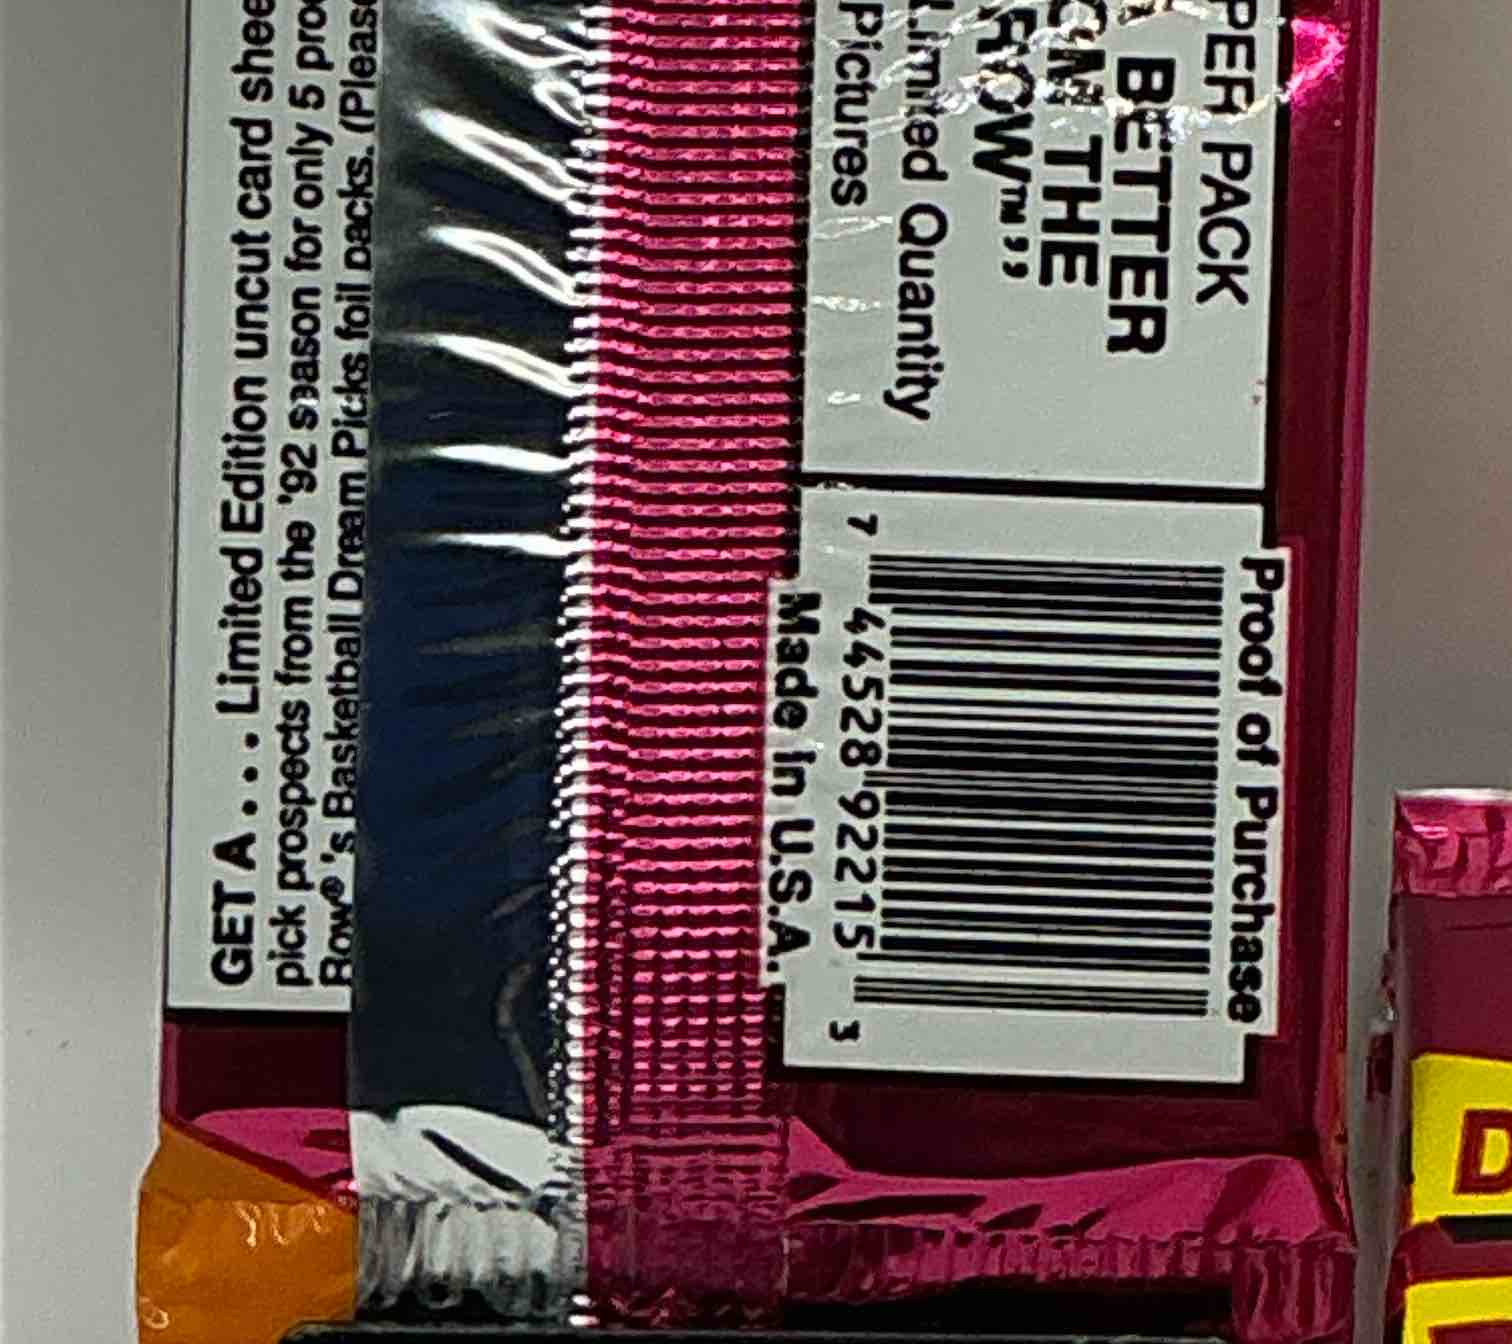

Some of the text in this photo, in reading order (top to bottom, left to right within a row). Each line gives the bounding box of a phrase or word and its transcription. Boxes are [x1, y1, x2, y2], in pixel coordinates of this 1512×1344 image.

[288, 83, 326, 111] 5
[830, 1, 884, 206] Pictures
[230, 118, 273, 220] card
[287, 122, 333, 210] only
[337, 145, 375, 272] packs.
[1039, 133, 1105, 287] THE
[1106, 57, 1176, 355] BETTER
[1196, 141, 1254, 306] PACK
[230, 229, 271, 359] uncut
[284, 216, 323, 273] for
[334, 282, 372, 342] foil
[883, 202, 948, 420] Quantity
[288, 285, 322, 432] season
[330, 350, 369, 458] Picks
[219, 376, 268, 533] Edition
[277, 519, 317, 584] the
[328, 470, 368, 603] Dream
[215, 547, 264, 714] Limited
[274, 595, 313, 687] from
[773, 592, 821, 730] Made
[322, 614, 361, 821] Basketball
[828, 514, 886, 1042] 7 44528 92215 3
[212, 832, 257, 871] A
[275, 699, 315, 893] prospects
[1227, 556, 1285, 1023] Proof of Purchase
[210, 880, 256, 987] GET
[267, 903, 313, 988] pick
[767, 817, 815, 974] U.S.A.
